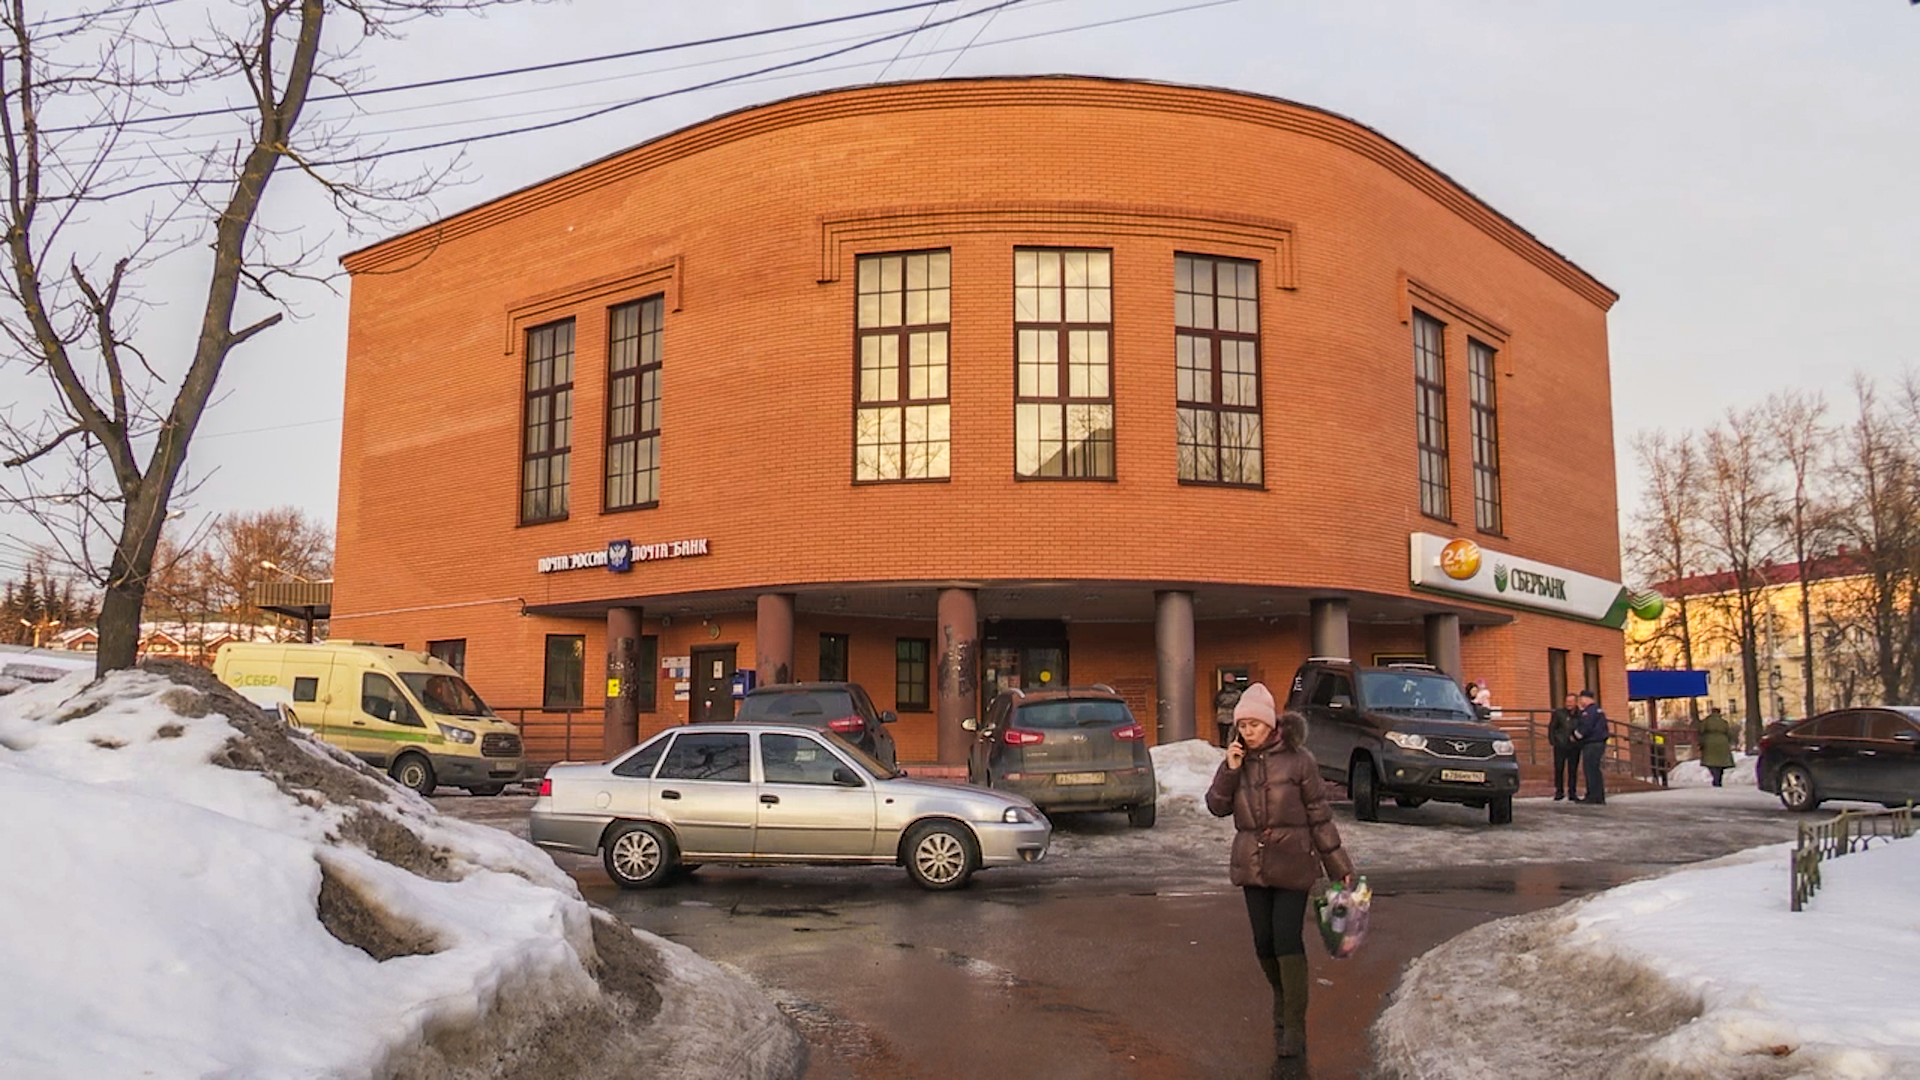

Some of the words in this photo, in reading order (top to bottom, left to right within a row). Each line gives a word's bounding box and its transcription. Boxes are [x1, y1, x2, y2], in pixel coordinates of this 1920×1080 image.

[538, 555, 569, 573] ПОЧТА
[569, 550, 608, 569] РОССИИ
[630, 543, 668, 562] ПОЧТА
[668, 538, 708, 557] БАНК
[1443, 548, 1466, 565] 24
[1511, 568, 1567, 601] СБЕРБАНК
[245, 674, 278, 687] СБЕР
